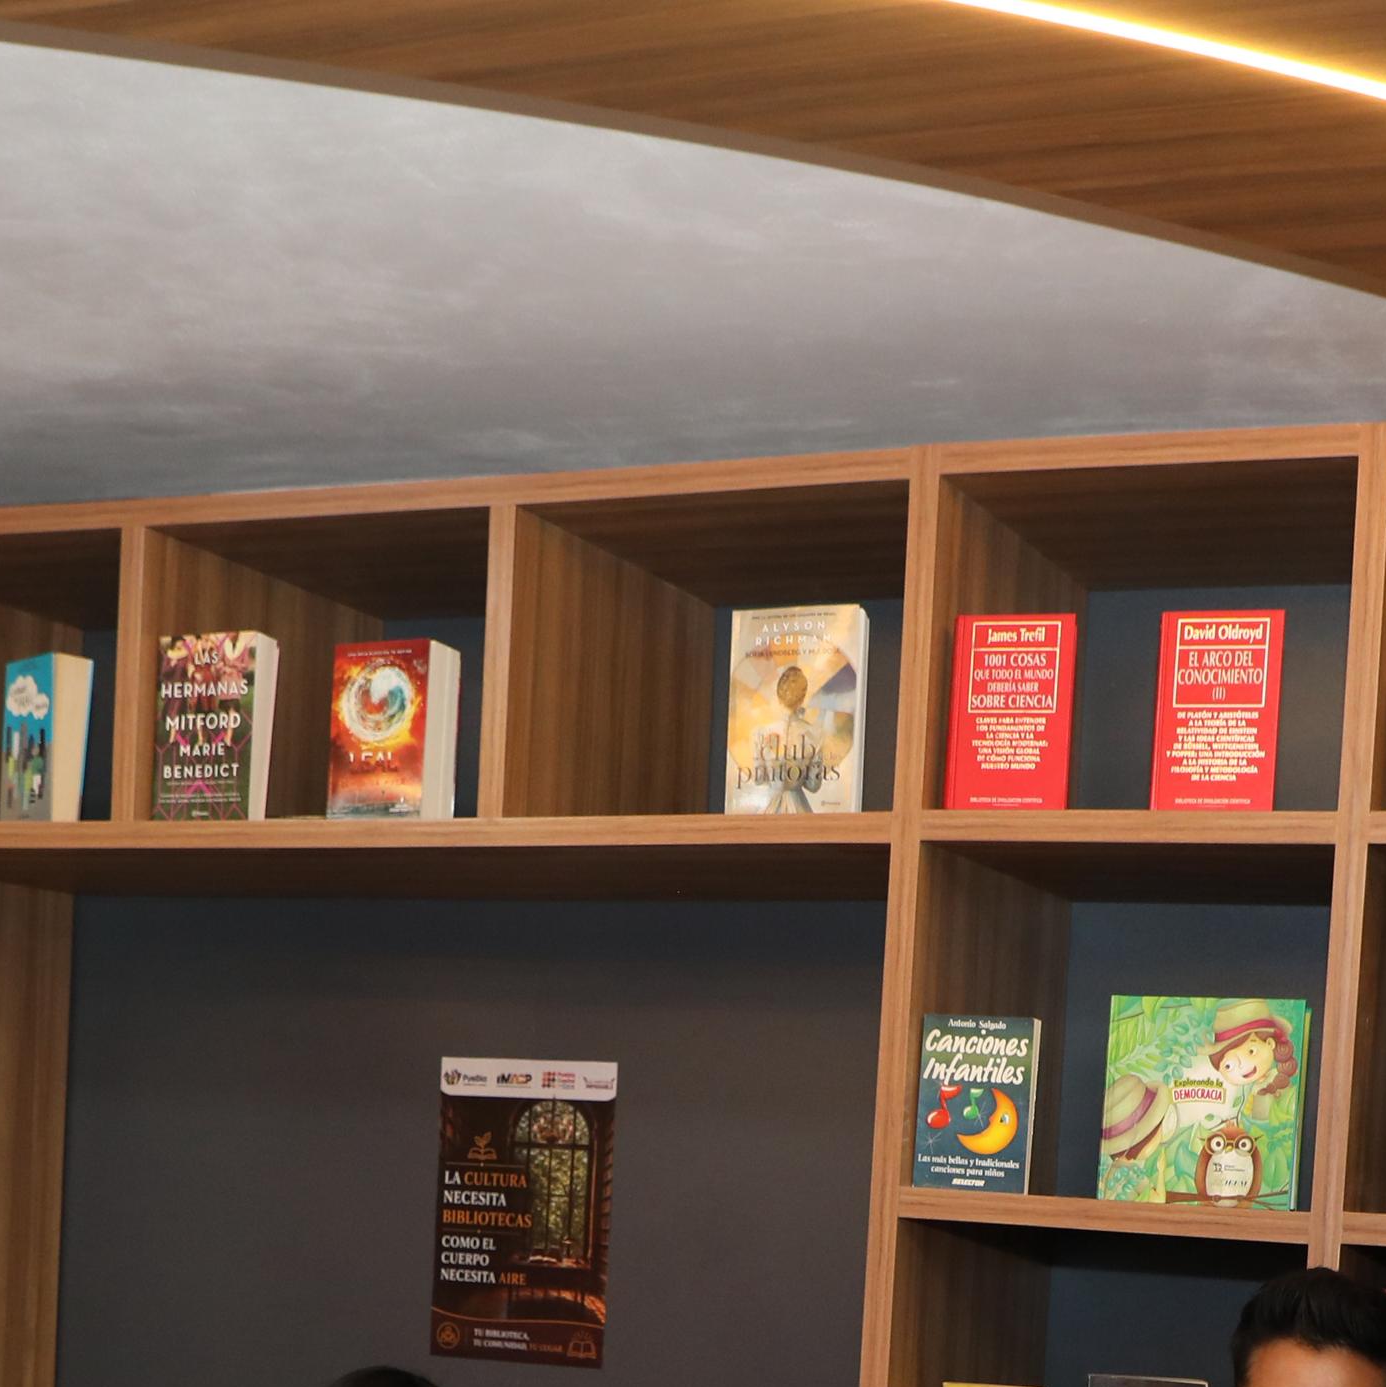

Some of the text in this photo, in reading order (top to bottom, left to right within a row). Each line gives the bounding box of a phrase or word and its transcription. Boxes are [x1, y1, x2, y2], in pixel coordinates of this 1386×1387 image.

[763, 620, 826, 632] ALYSON
[1184, 624, 1263, 643] David Oldroyd
[755, 634, 833, 646] RICHMAN
[987, 627, 1046, 643] James Trefil
[194, 651, 219, 665] LAS
[984, 653, 1046, 667] 1001 COSAS
[1189, 651, 1253, 667] EL ARCO DEL
[974, 669, 1053, 682] QUE TODO EL MUNDO
[1178, 668, 1262, 685] CONOCIMIENTO
[161, 679, 248, 698] HERMANAS
[1018, 681, 1038, 692] SABER
[1212, 686, 1226, 700] (II)
[971, 694, 1053, 708] SOBRE CIENCIA
[166, 712, 241, 731] MITFORD
[179, 743, 225, 757] MARIE
[163, 764, 239, 779] BENEDICT
[737, 763, 841, 789] pintoras
[948, 1019, 1006, 1031] Antonio Salgado
[925, 1029, 1029, 1057] Canciones
[923, 1054, 1025, 1085] Infantiles
[1174, 1079, 1214, 1089] Explorando
[1173, 1089, 1222, 1101] DEMOCRACIA
[918, 1154, 931, 1163] Las
[948, 1155, 968, 1166] bellas
[976, 1158, 1020, 1169] tradicionales
[931, 1165, 964, 1175] canciones
[966, 1168, 983, 1177] para
[444, 1170, 527, 1188] LA CULTURA
[443, 1190, 506, 1207] NECESITA
[443, 1210, 532, 1228] BIBLIOTECAS
[441, 1235, 496, 1250] COMO EL
[441, 1252, 489, 1266] CUERPO
[441, 1268, 527, 1286] NECESITA AIRE
